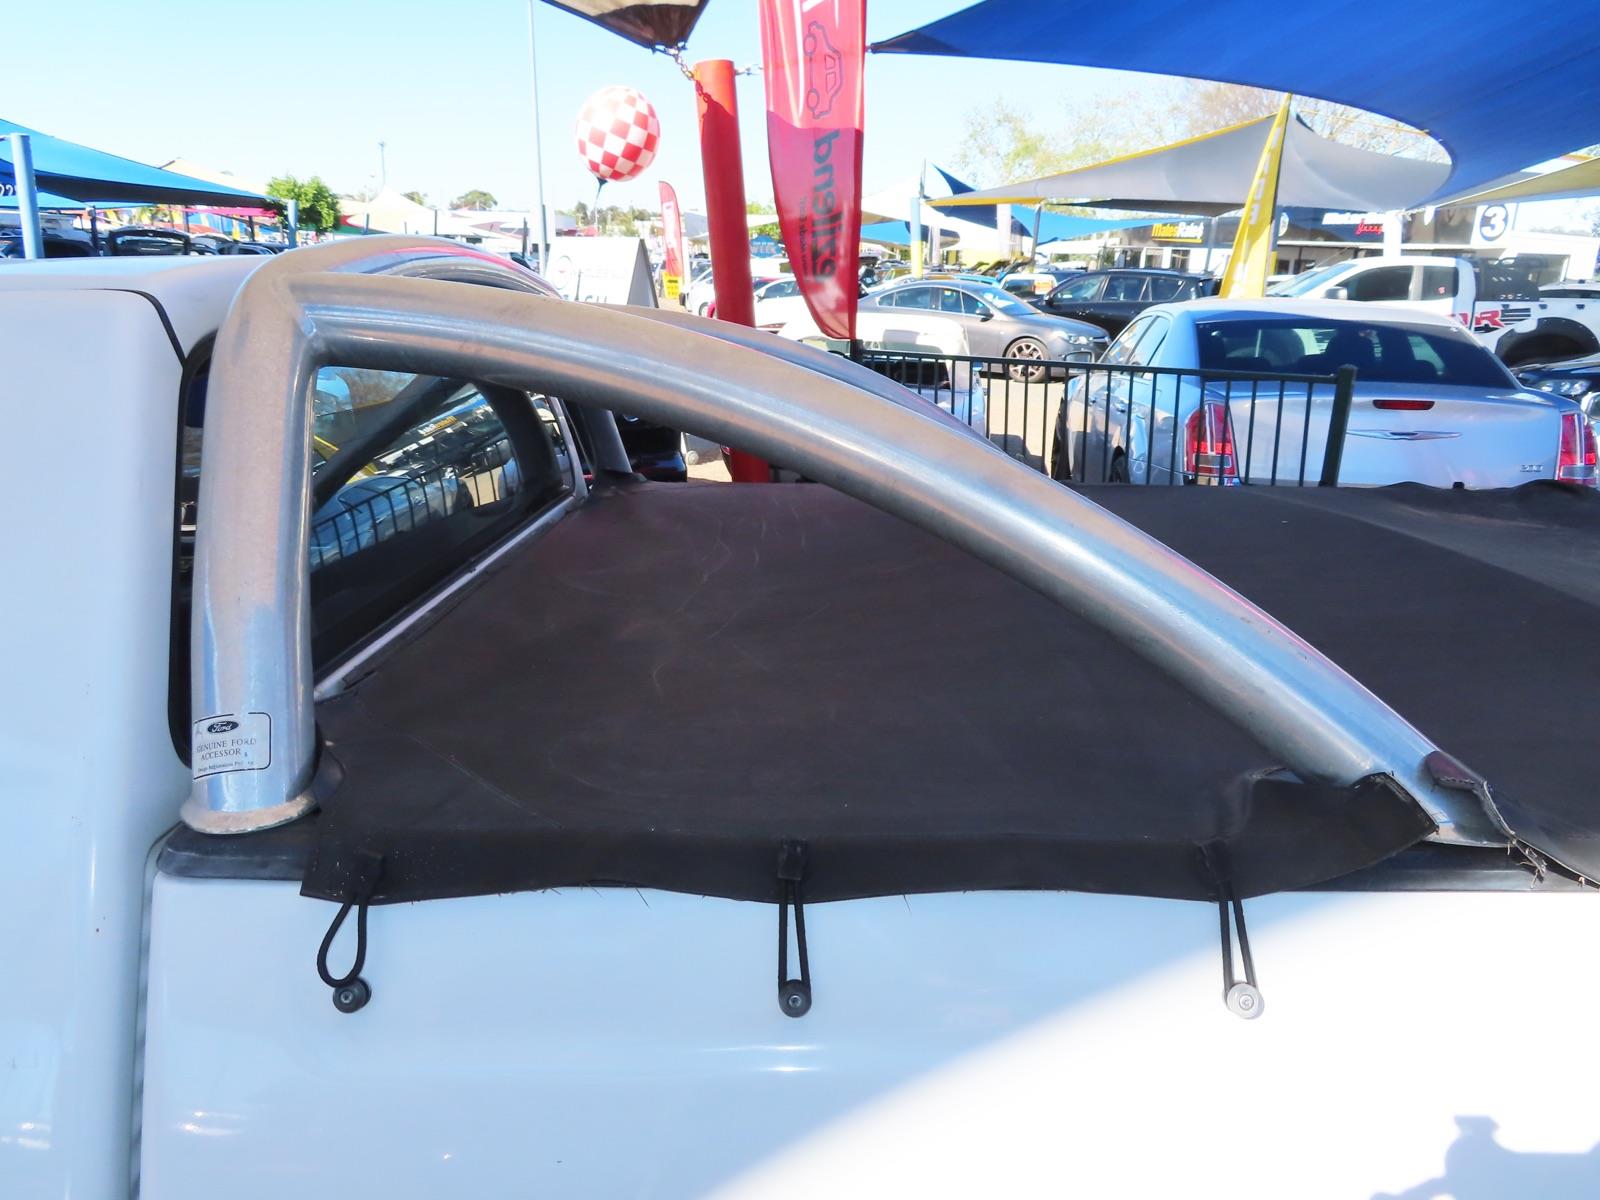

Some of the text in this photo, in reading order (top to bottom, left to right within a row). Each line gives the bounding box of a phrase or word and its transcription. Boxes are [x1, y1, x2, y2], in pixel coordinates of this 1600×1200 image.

[1481, 206, 1507, 238] 3
[210, 721, 233, 733] Ford
[231, 738, 257, 747] FORD
